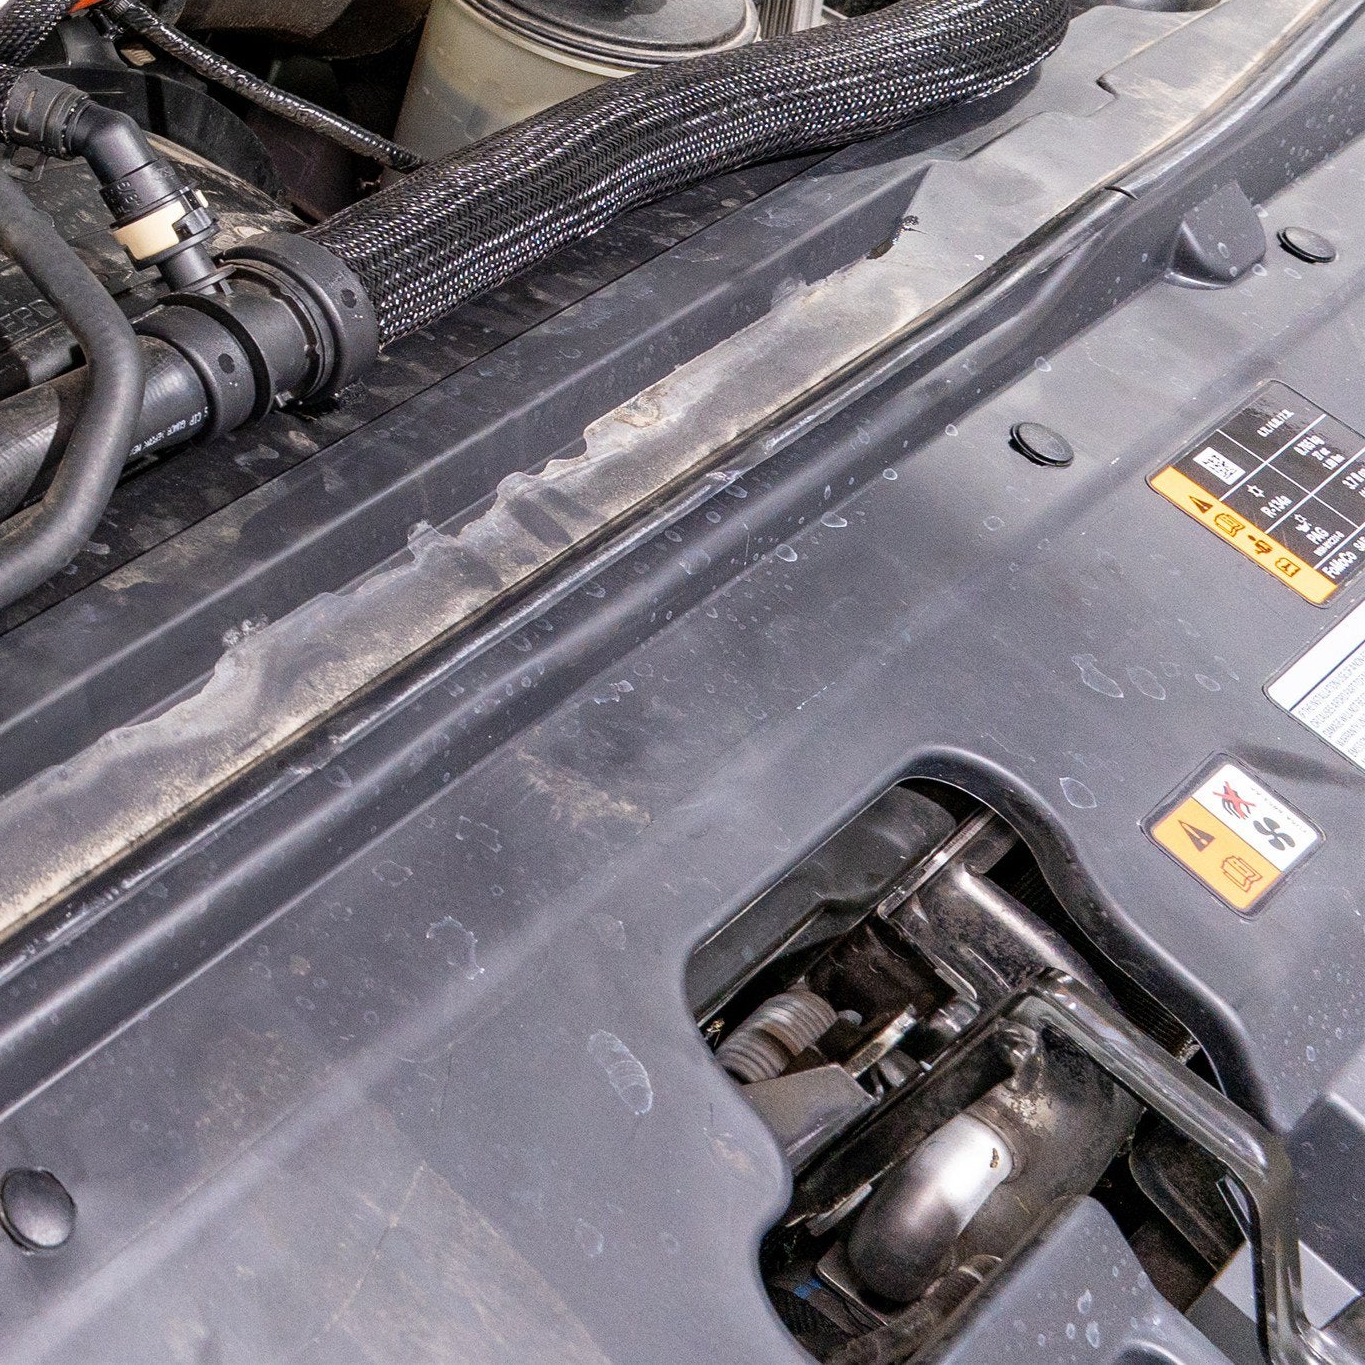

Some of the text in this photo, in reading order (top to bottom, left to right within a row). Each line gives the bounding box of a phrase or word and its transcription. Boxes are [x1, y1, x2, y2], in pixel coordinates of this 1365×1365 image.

[1259, 492, 1293, 518] R-134a
[1304, 525, 1330, 545] PAG
[1322, 549, 1358, 579] FoMoCo
